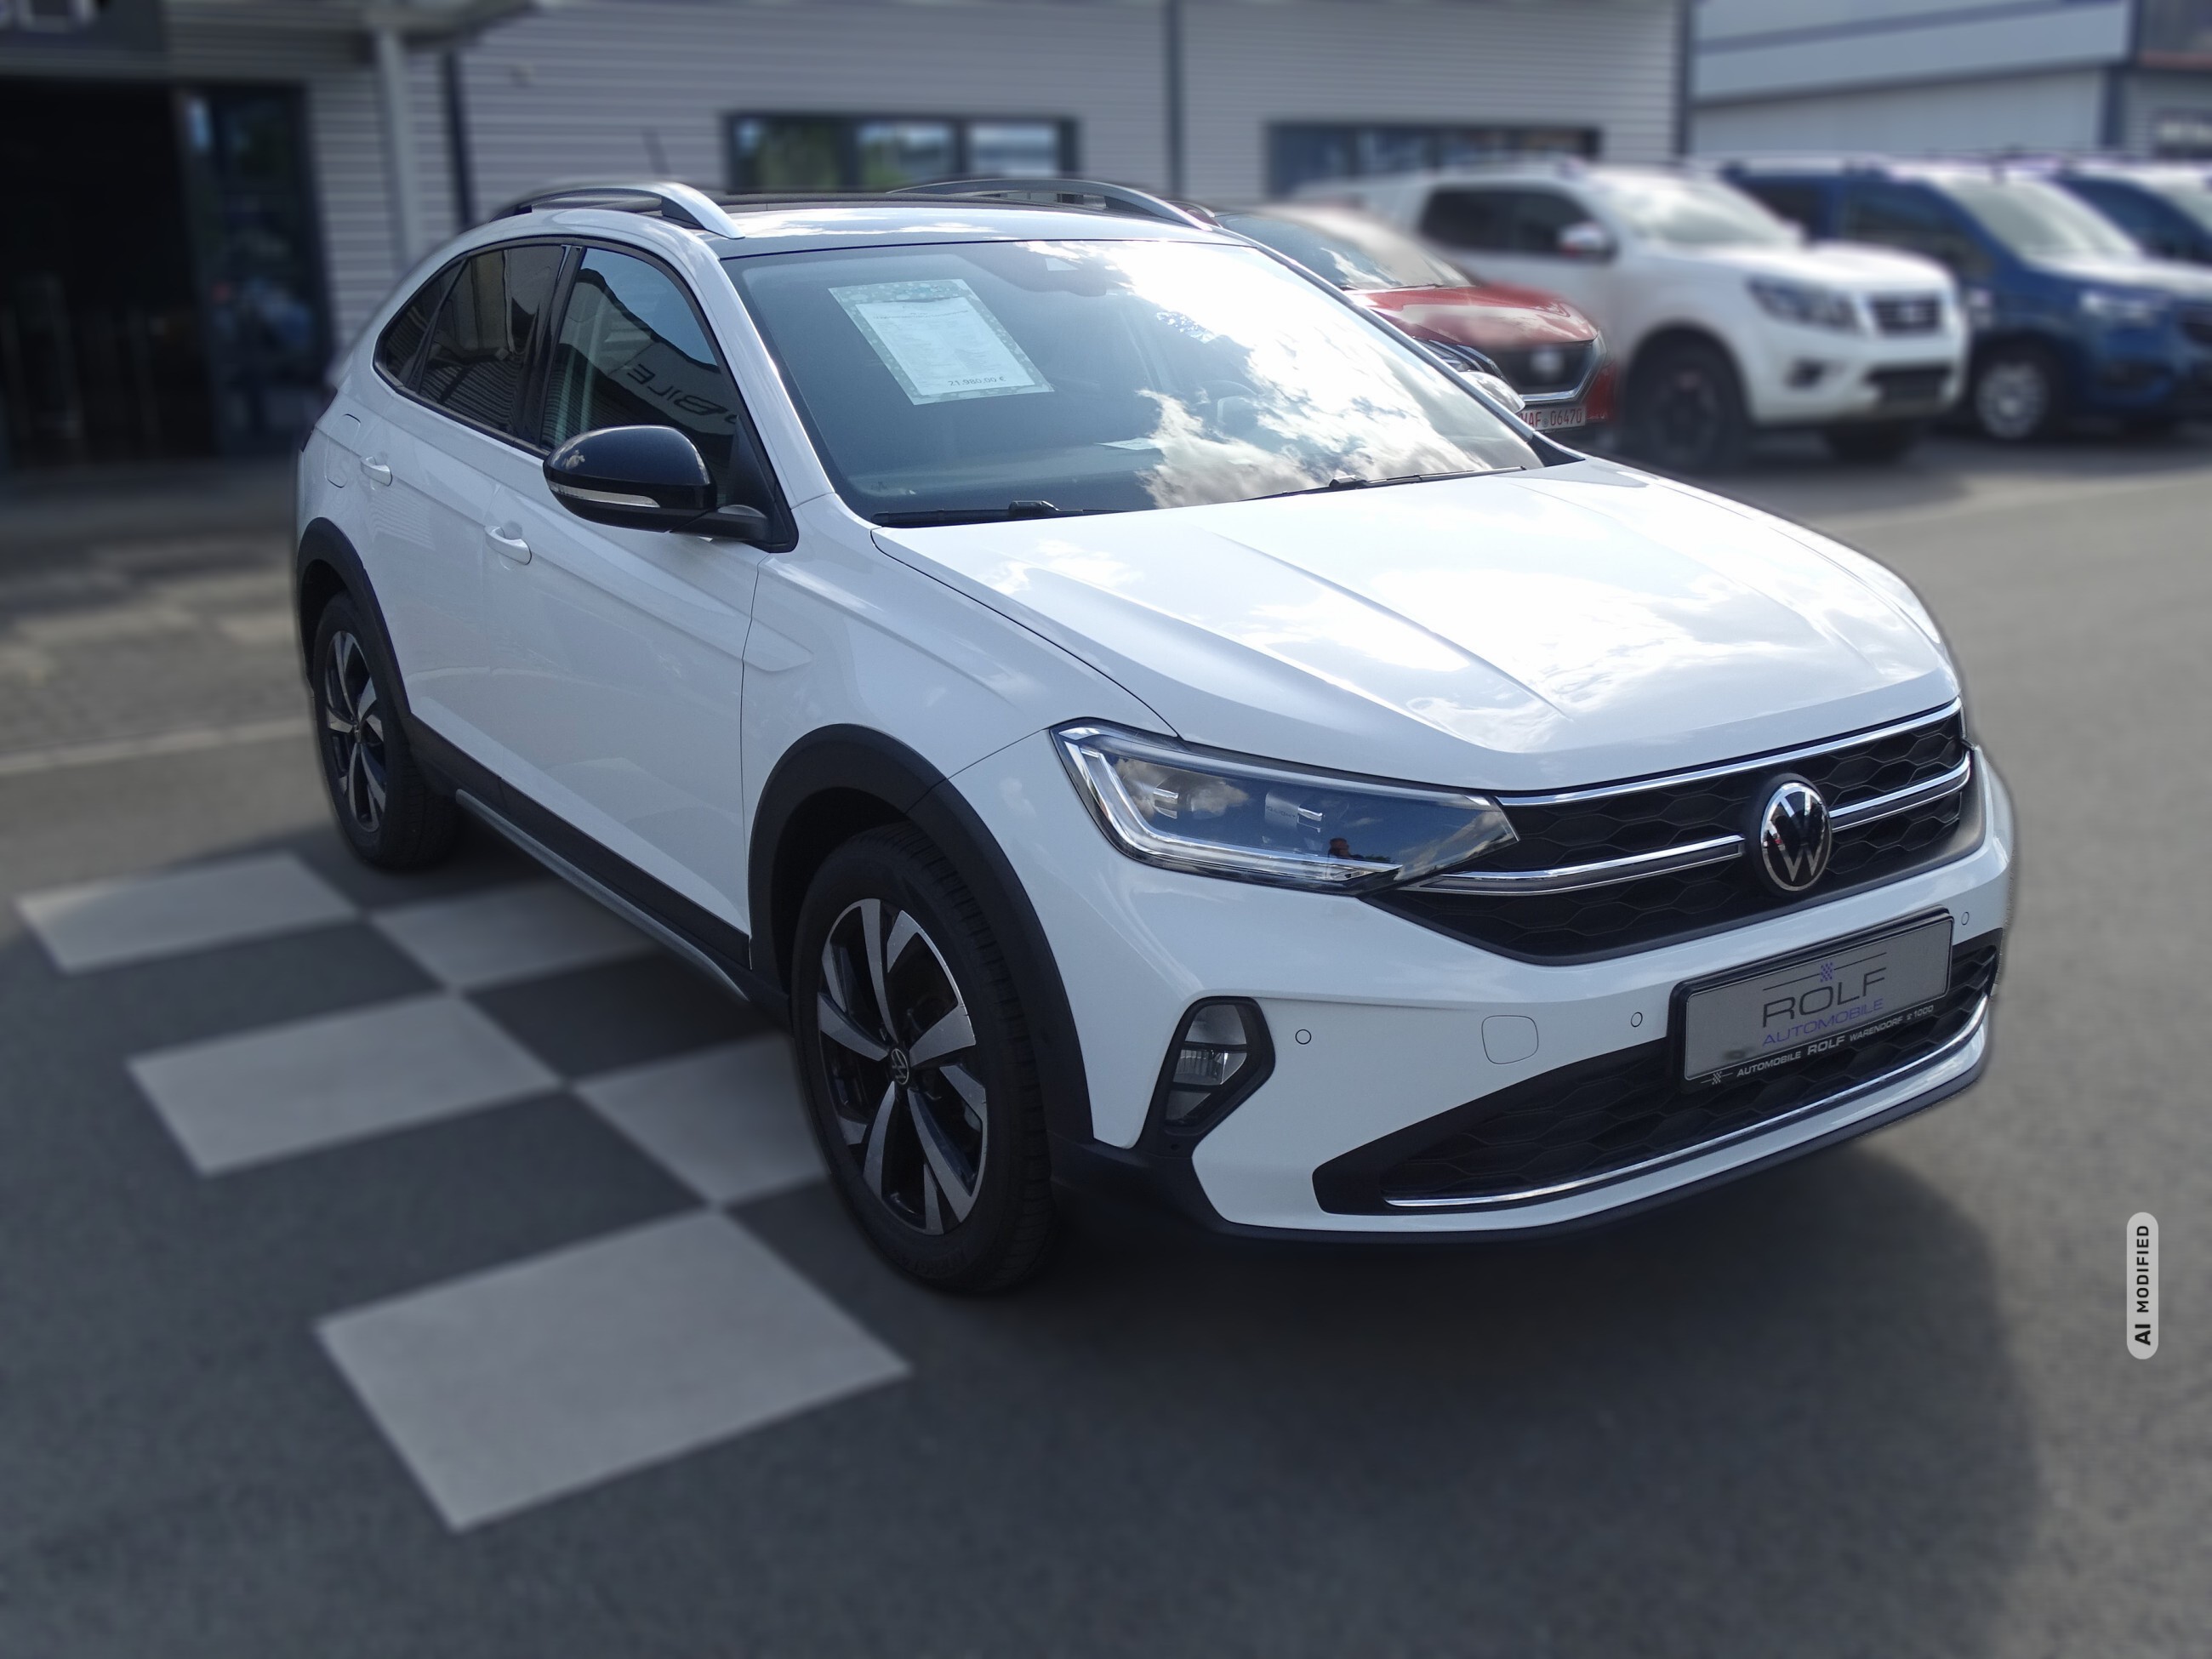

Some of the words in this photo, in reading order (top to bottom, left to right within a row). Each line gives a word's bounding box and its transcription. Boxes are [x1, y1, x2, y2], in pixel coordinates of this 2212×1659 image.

[1551, 408, 1582, 426] 06470
[1762, 966, 1886, 1028] ROLF
[1762, 998, 1884, 1046] AUTOMOBILE
[1736, 1051, 1802, 1077] AUTOMOBILE
[1807, 1035, 1845, 1056] ROLF
[1850, 1016, 1903, 1041] WARENDORF
